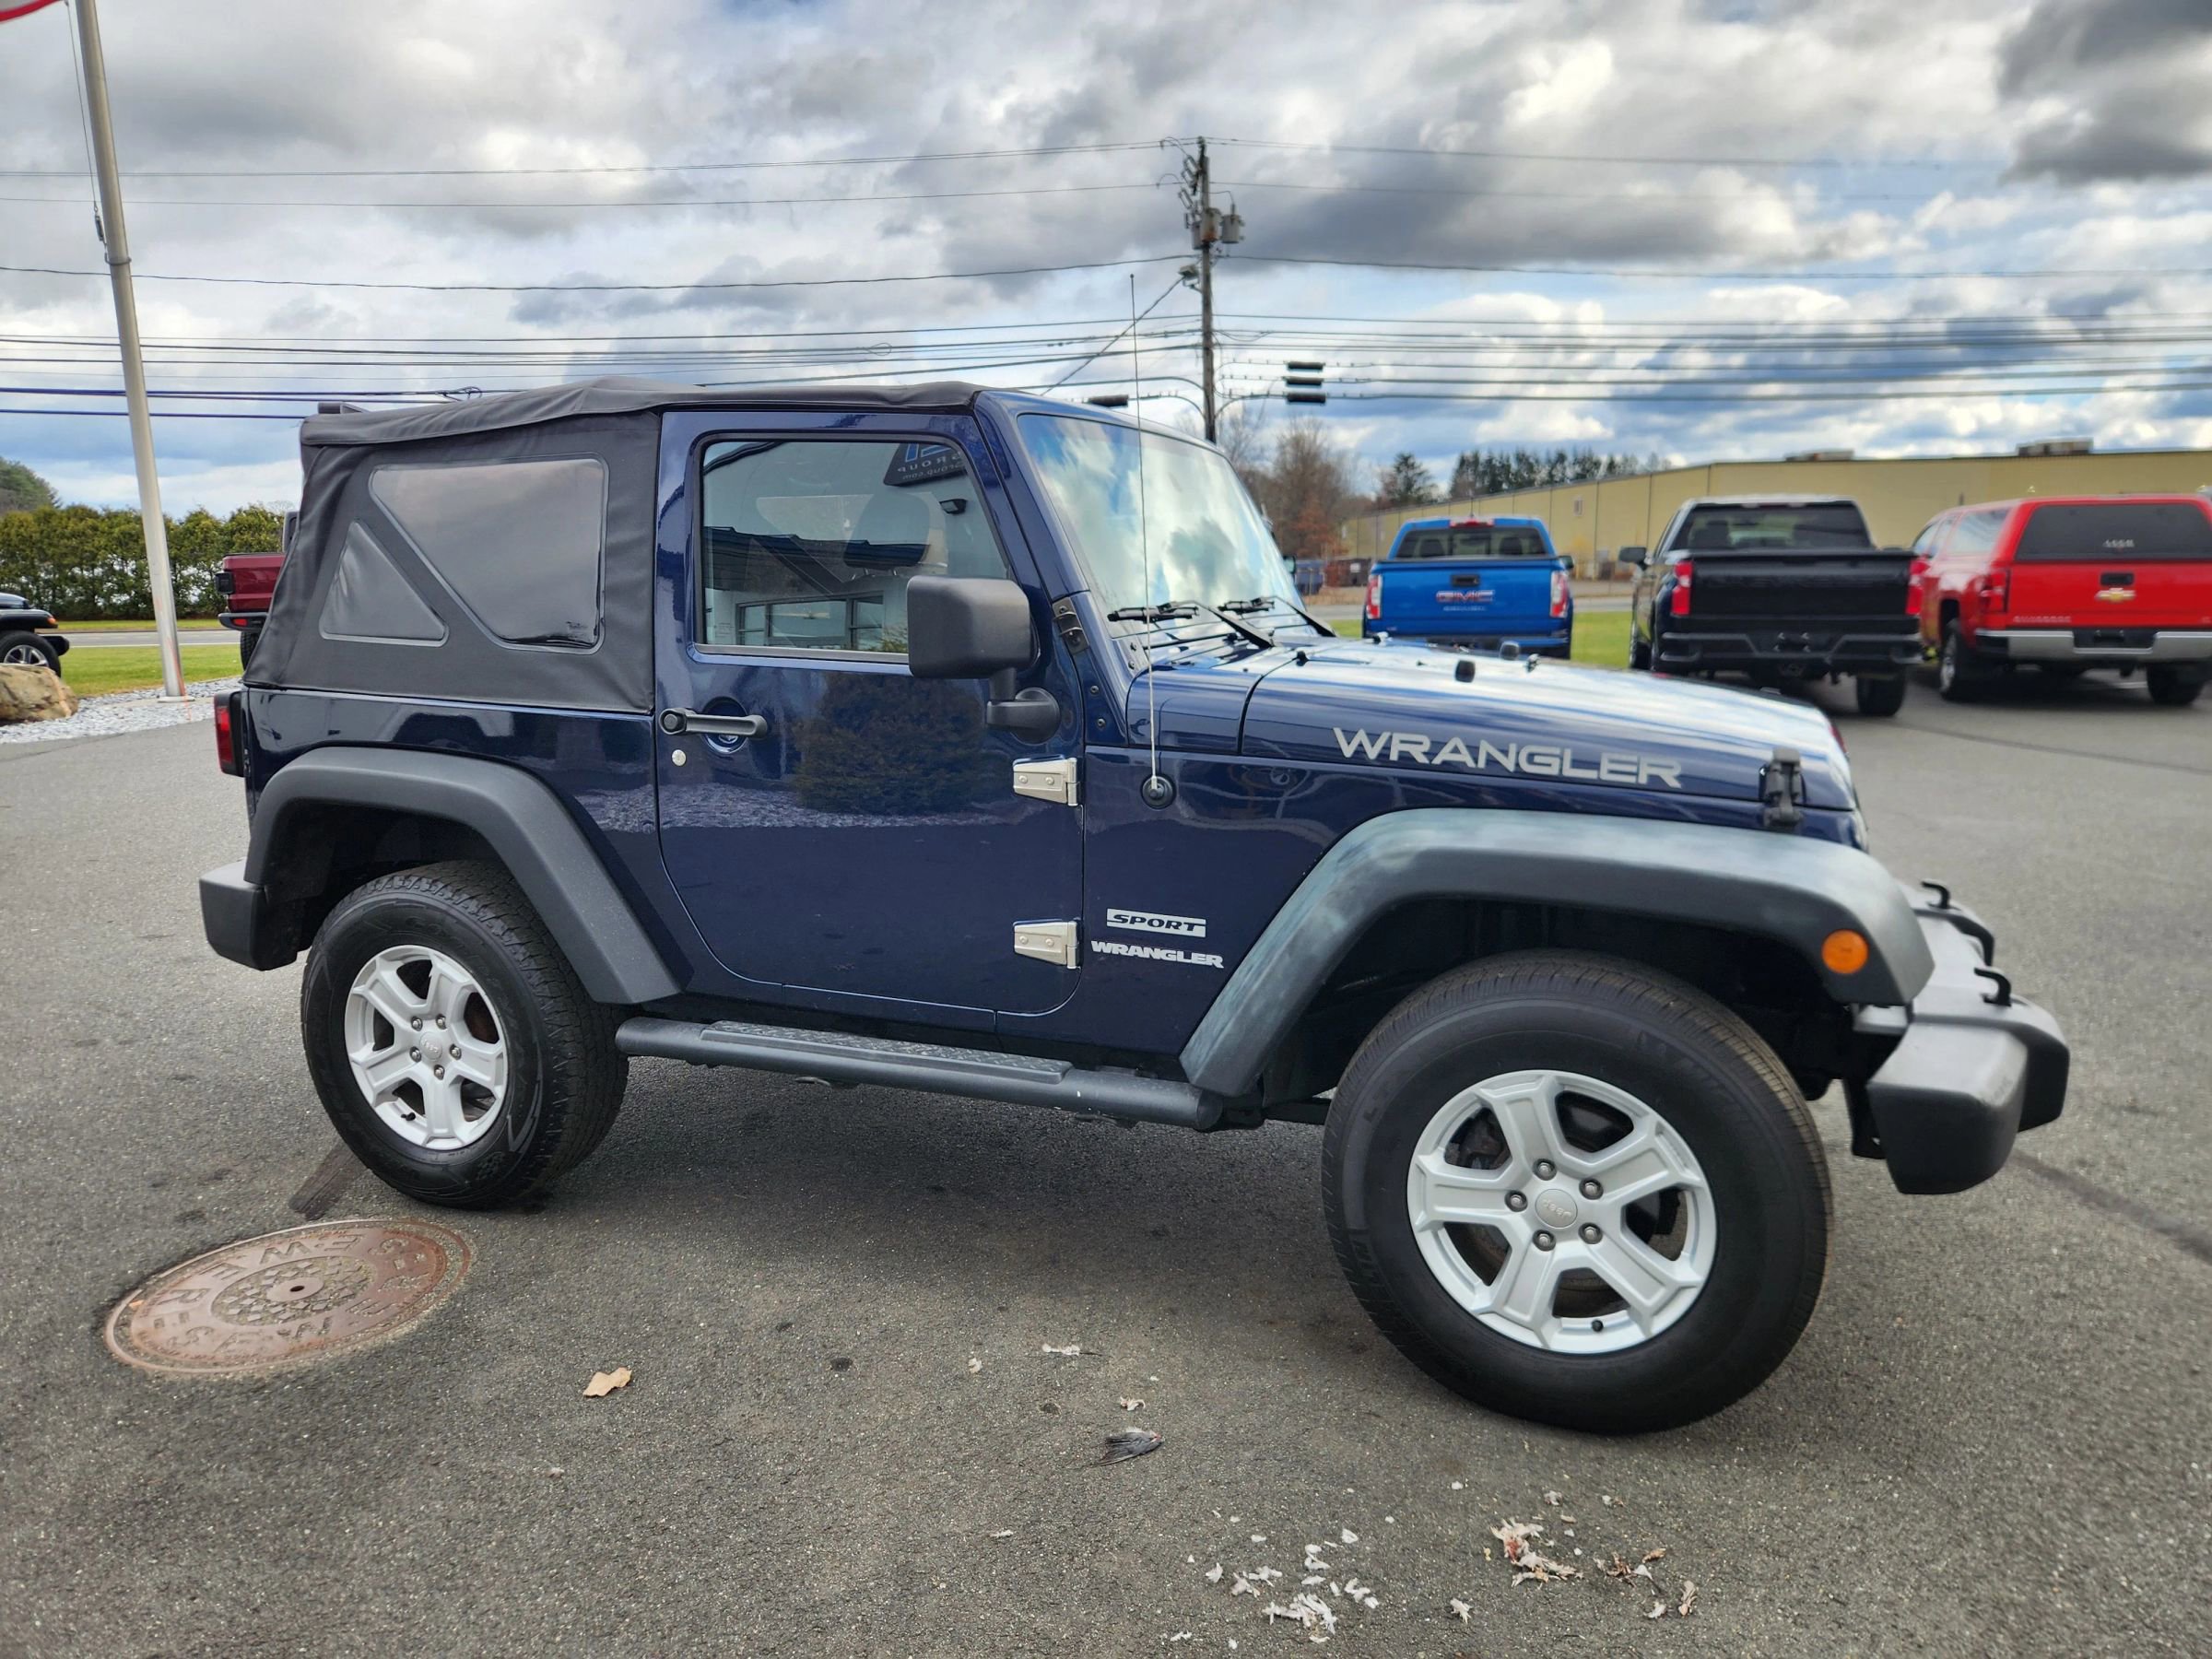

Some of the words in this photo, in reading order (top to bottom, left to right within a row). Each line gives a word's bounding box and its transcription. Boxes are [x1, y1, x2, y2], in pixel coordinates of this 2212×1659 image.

[1436, 590, 1495, 603] GMC
[1333, 727, 1683, 789] WRANGLER
[1112, 913, 1206, 933] SPORT
[1090, 940, 1224, 969] WRANGLER
